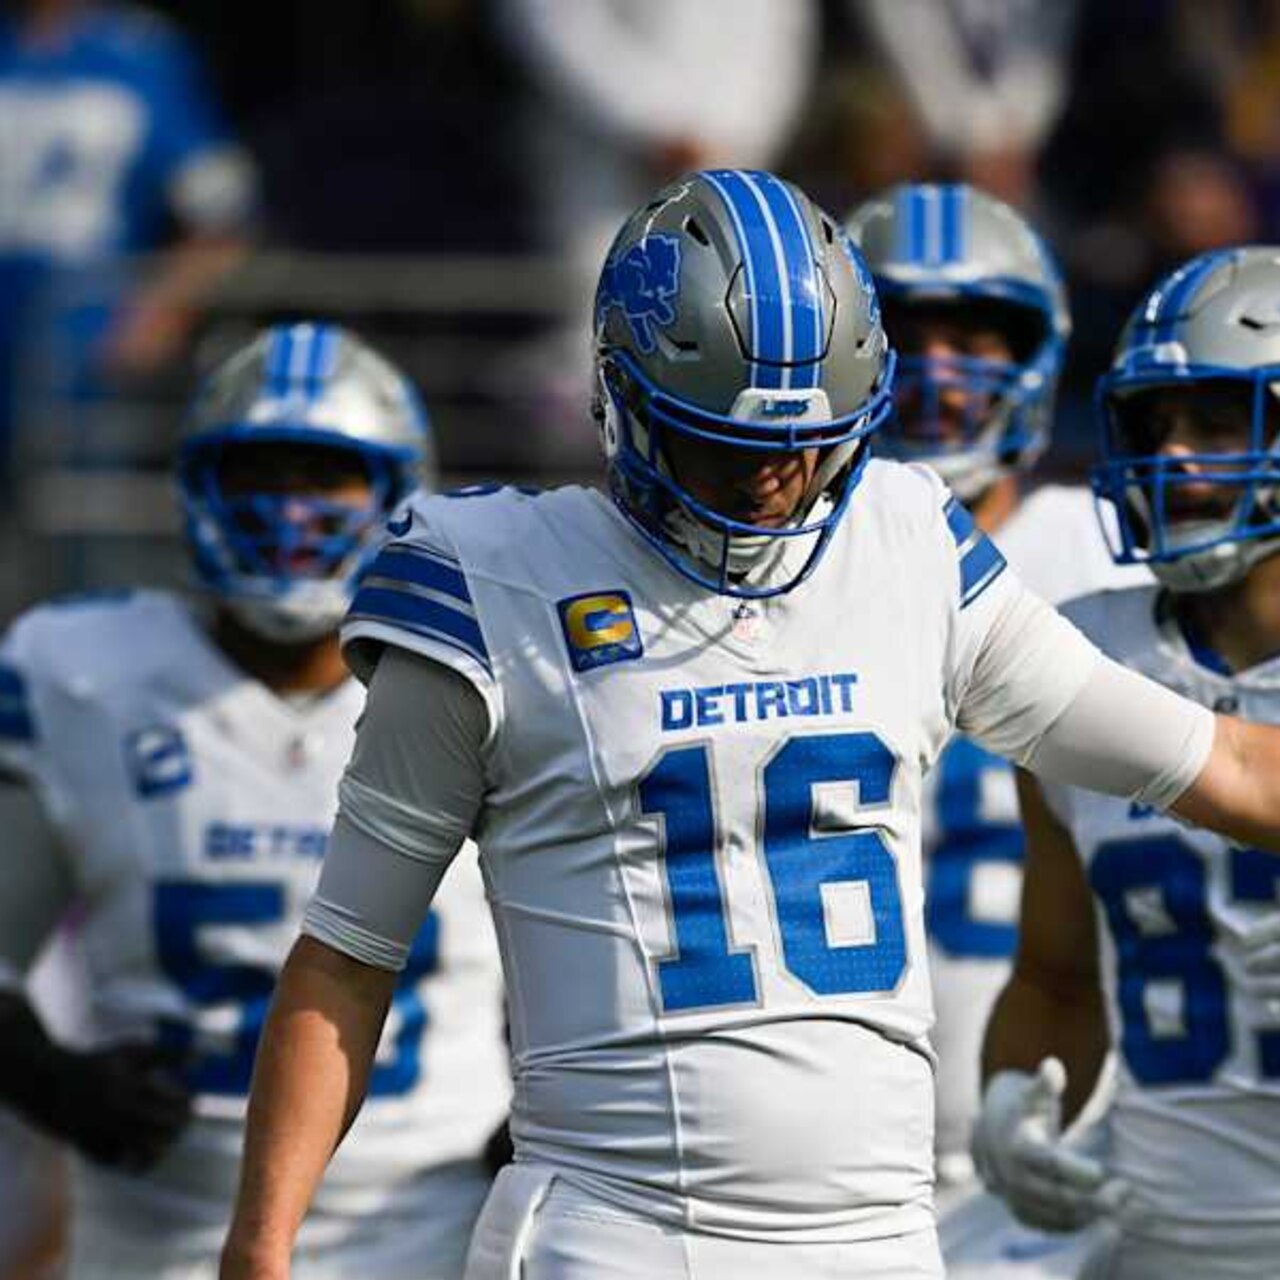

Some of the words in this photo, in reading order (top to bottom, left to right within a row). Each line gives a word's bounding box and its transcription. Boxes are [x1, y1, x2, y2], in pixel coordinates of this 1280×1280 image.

[566, 597, 633, 650] C
[658, 673, 858, 732] DETROIT
[635, 729, 911, 1012] 16
